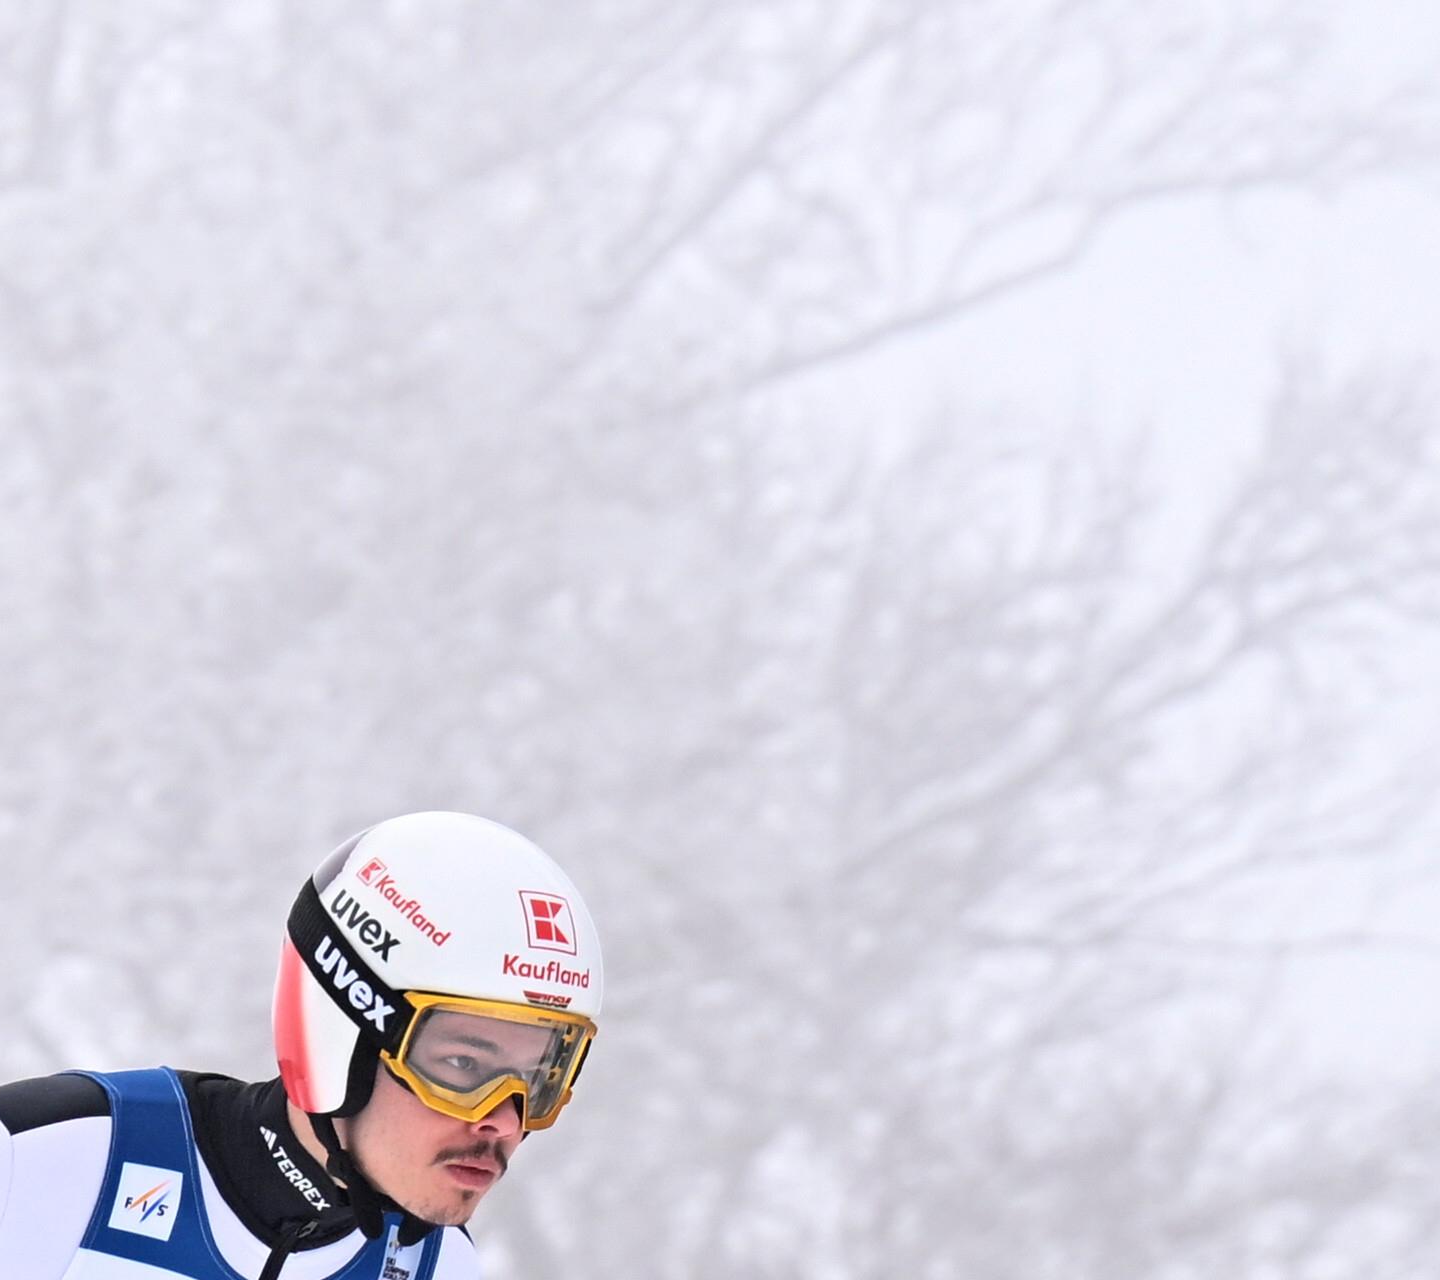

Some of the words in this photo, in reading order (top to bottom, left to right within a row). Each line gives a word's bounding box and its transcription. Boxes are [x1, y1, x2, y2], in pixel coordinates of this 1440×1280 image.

[330, 888, 401, 963] uvex
[375, 875, 451, 946] Kaufland
[314, 935, 395, 1032] uvex
[503, 954, 590, 988] Kaufland
[272, 1146, 331, 1211] TERREX
